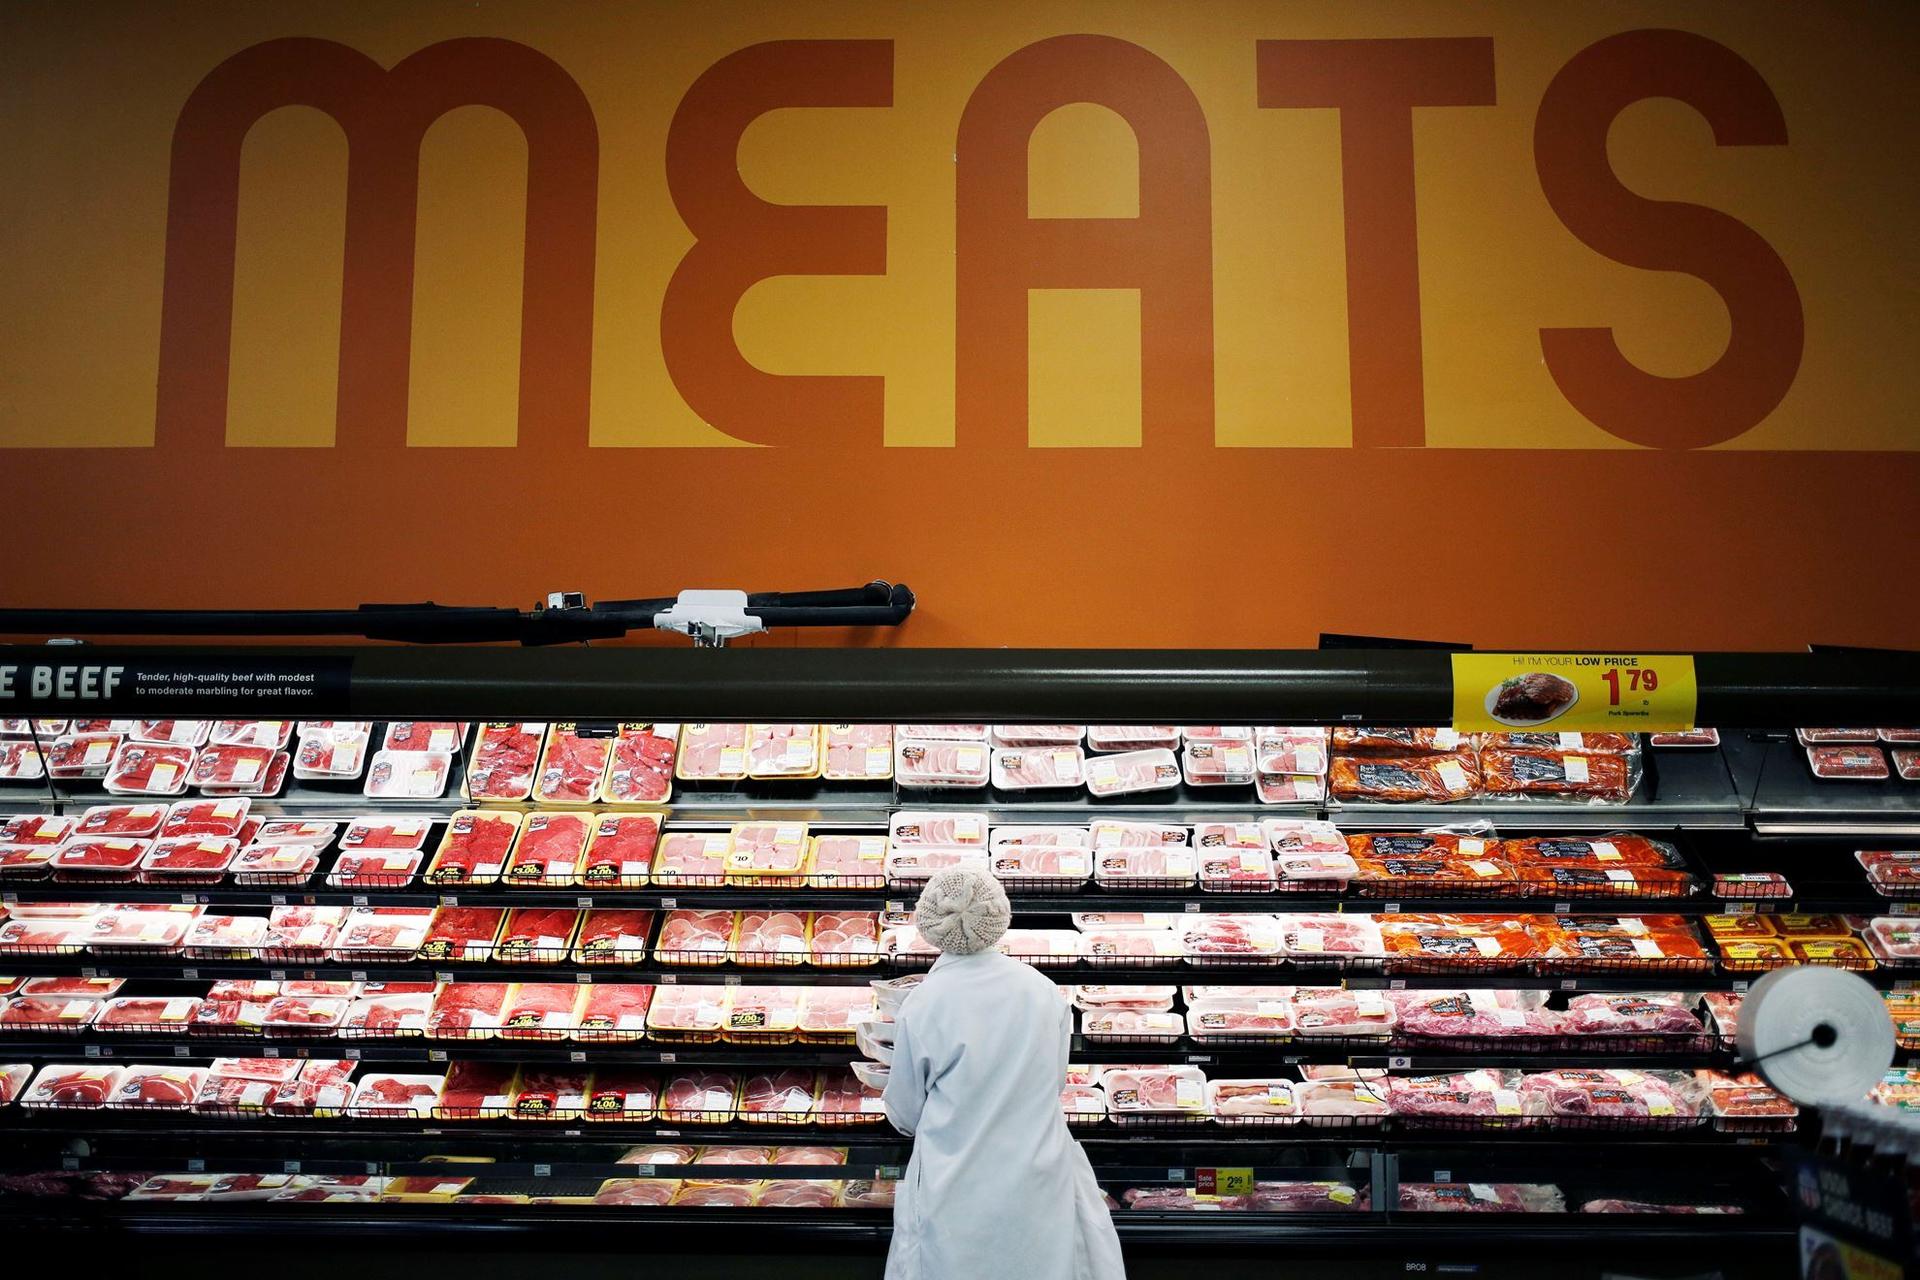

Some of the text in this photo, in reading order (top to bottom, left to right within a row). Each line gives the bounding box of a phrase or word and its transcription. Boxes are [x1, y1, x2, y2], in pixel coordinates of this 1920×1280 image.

[154, 28, 1804, 450] MEATS
[1544, 657, 1573, 666] YOUR
[1575, 657, 1600, 666] LOW
[1604, 657, 1638, 666] PRICE
[31, 665, 125, 699] BEEF
[136, 671, 315, 683] Tender, high-quality beef with modest
[136, 686, 314, 698] to moderate marbling for great flavor.
